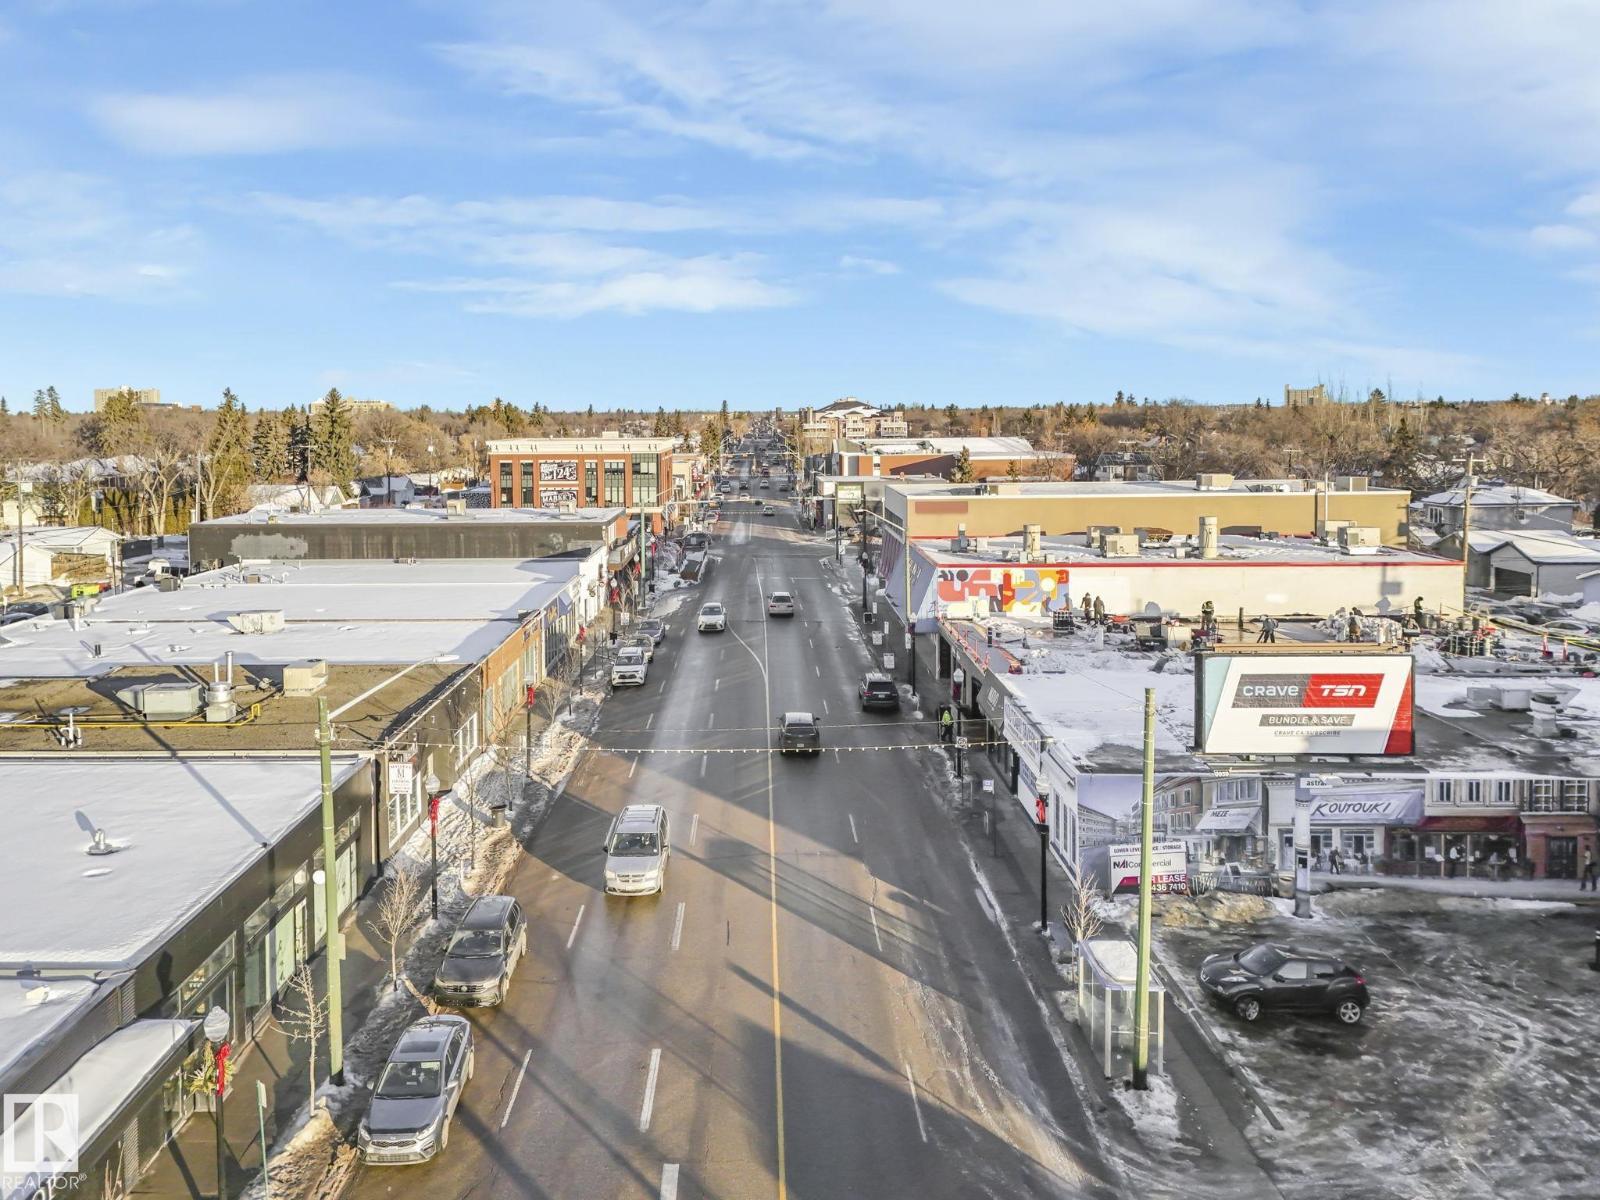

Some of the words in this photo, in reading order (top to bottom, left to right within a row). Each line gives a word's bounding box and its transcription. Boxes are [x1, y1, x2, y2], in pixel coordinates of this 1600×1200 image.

[1320, 685, 1367, 697] TSN
[1268, 716, 1309, 724] BUNDLE
[1311, 716, 1319, 724] &
[1320, 716, 1345, 724] SAVE
[1311, 802, 1391, 816] KOUTOUKI
[1158, 875, 1186, 883] LEASE
